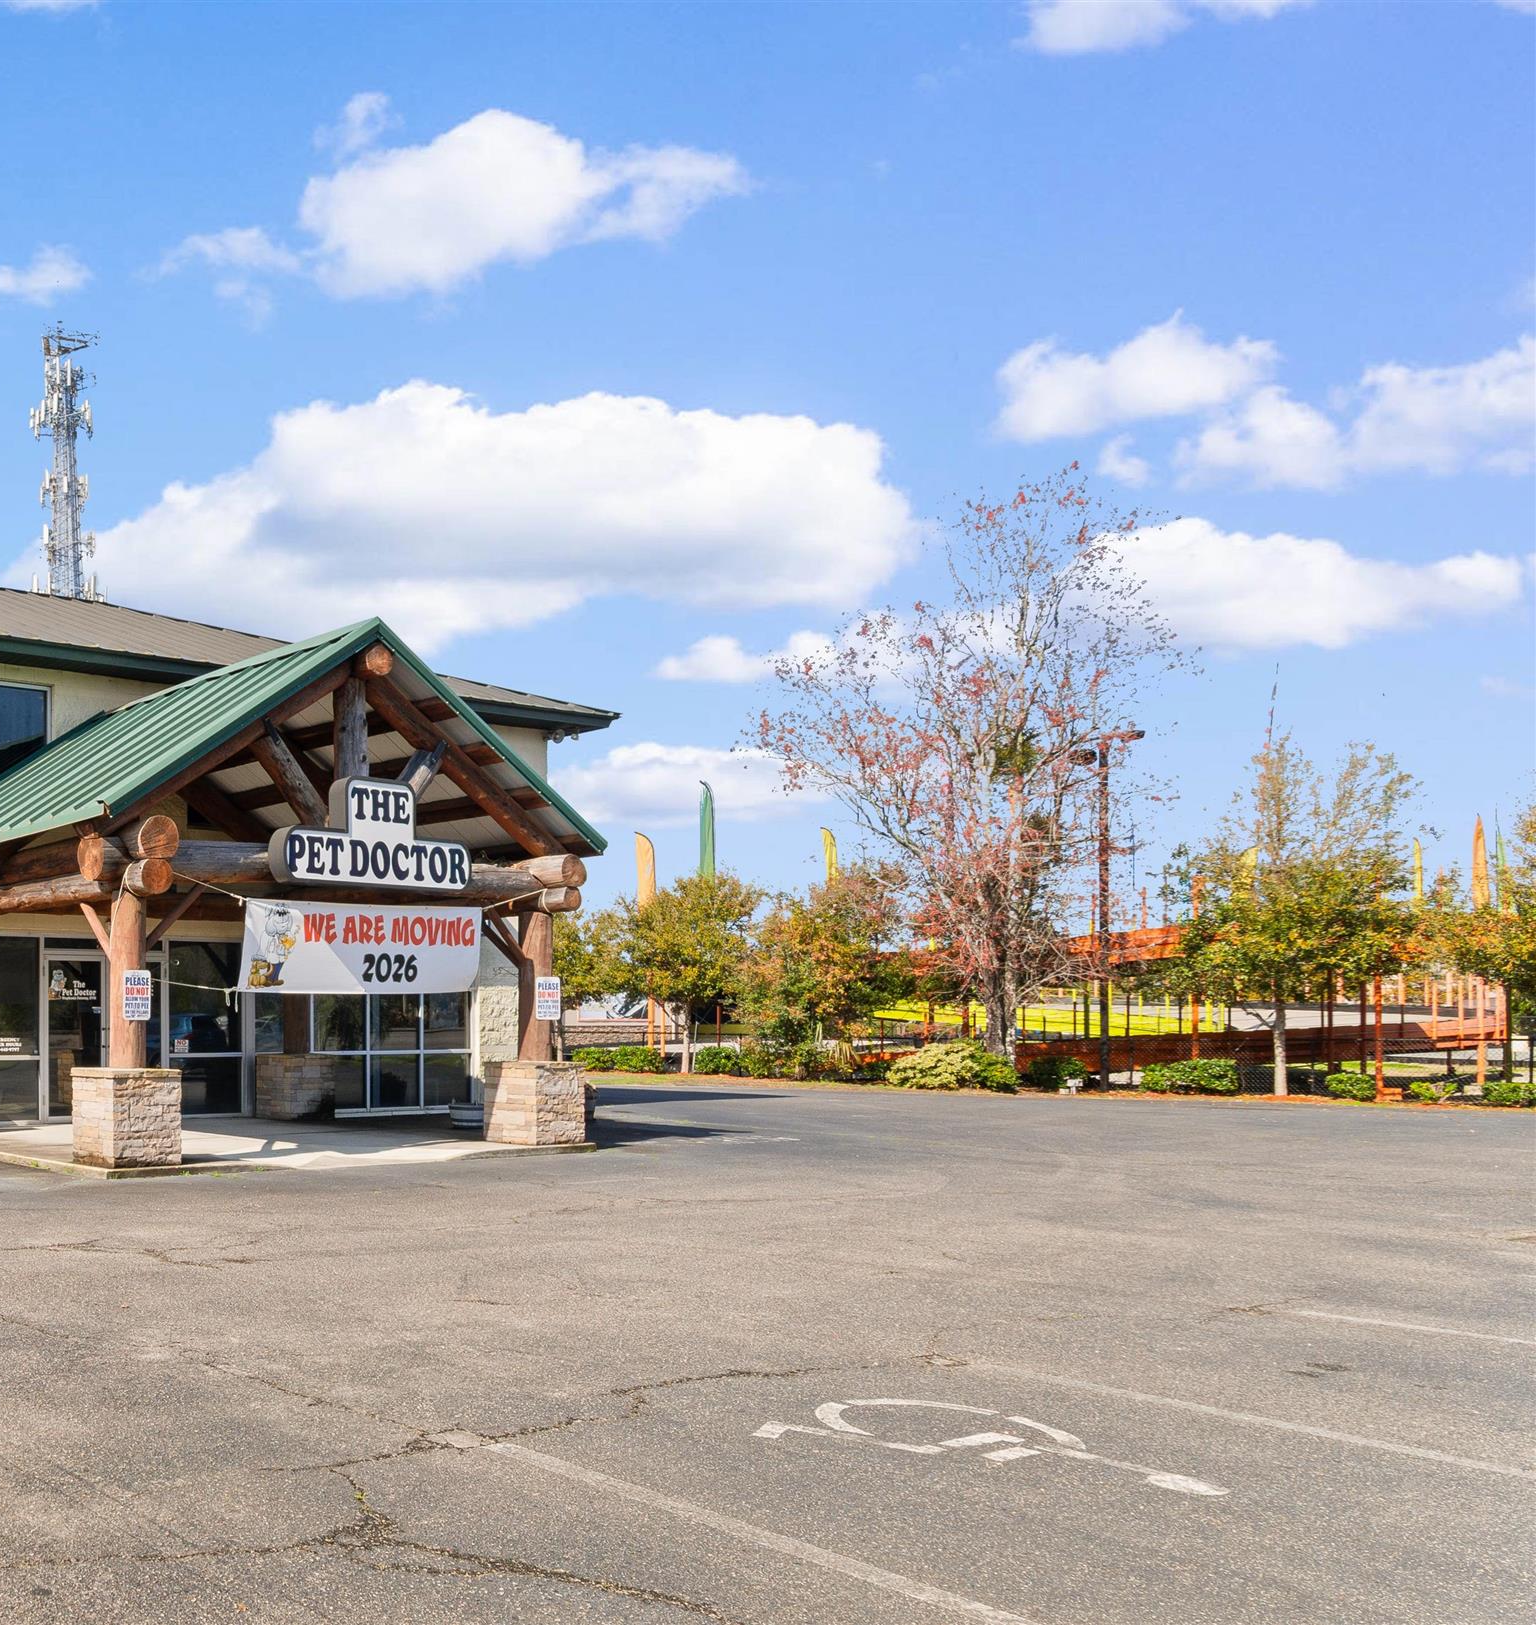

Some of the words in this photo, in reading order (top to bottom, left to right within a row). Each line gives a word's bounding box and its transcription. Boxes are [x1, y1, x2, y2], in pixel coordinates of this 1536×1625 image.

[351, 786, 410, 825] THE
[287, 834, 344, 876] PET
[349, 839, 467, 885] DOCTOR
[303, 913, 336, 945] WE
[342, 914, 387, 945] ARE
[391, 915, 475, 948] MOVING
[362, 953, 418, 983] 2026
[72, 980, 86, 988] The
[125, 976, 149, 986] PLEASE
[538, 982, 559, 990] PLEASE
[62, 988, 73, 996] Pet
[74, 988, 97, 996] Doctor
[125, 987, 135, 996] DO
[136, 987, 149, 996] NOT
